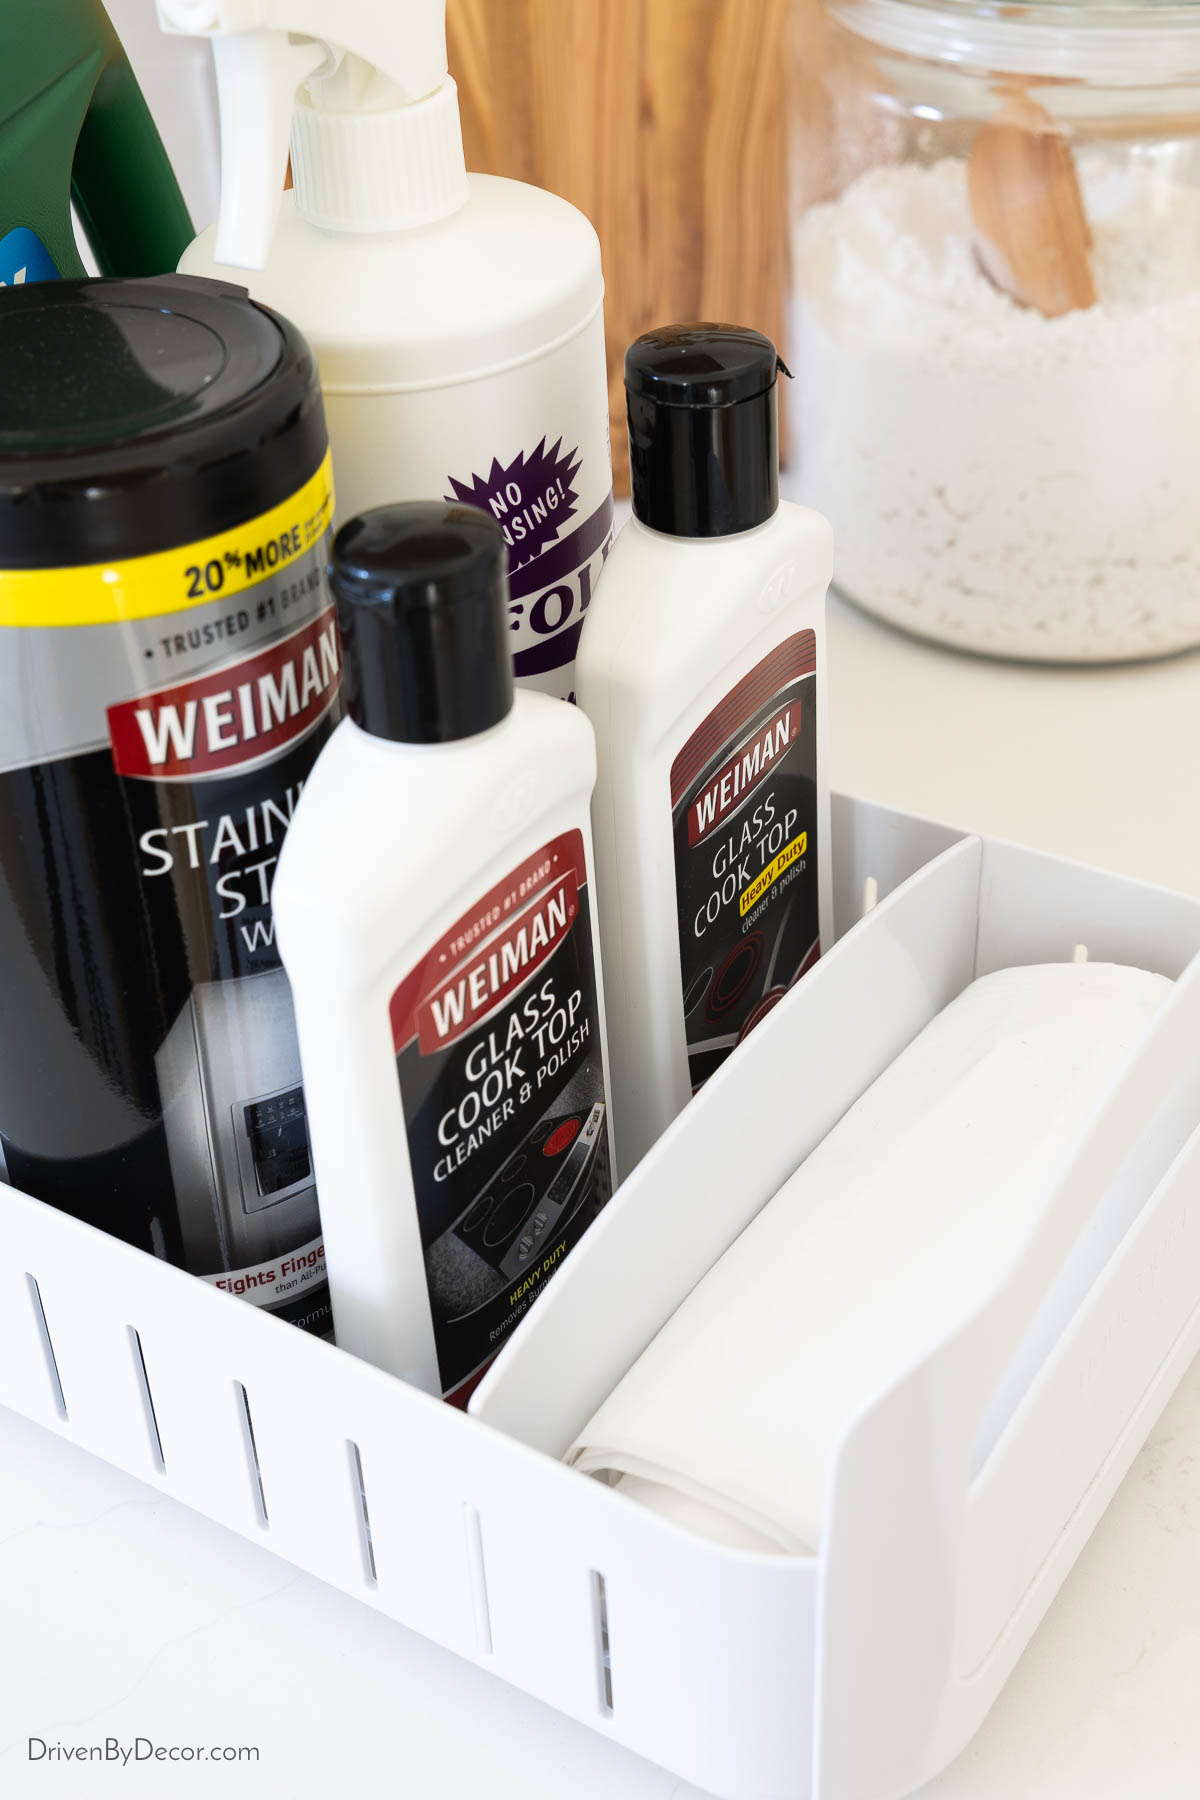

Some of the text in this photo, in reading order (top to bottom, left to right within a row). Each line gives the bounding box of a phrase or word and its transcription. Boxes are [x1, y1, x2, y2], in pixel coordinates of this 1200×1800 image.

[488, 482, 522, 519] NO
[161, 612, 249, 658] TRUSTED
[256, 599, 277, 621] #1
[134, 621, 340, 765] WEIMAN
[695, 710, 791, 834] WEIMAN
[694, 808, 798, 939] COOK TOP
[712, 792, 775, 879] GLASS
[741, 837, 805, 910] Heavy Duty
[449, 859, 551, 956] TRUSTED #1 BRAND
[741, 859, 806, 934] cleaner & polish
[430, 887, 567, 1038] WEIMAN
[436, 989, 581, 1147] COOK TOP
[464, 977, 555, 1082] GLASS
[432, 1018, 589, 1183] CLEANER & POLISH
[215, 1245, 325, 1295] Fights Finge
[274, 1278, 298, 1294] than
[509, 1240, 567, 1305] HEAVY DUTY
[489, 1302, 528, 1342] Removes
